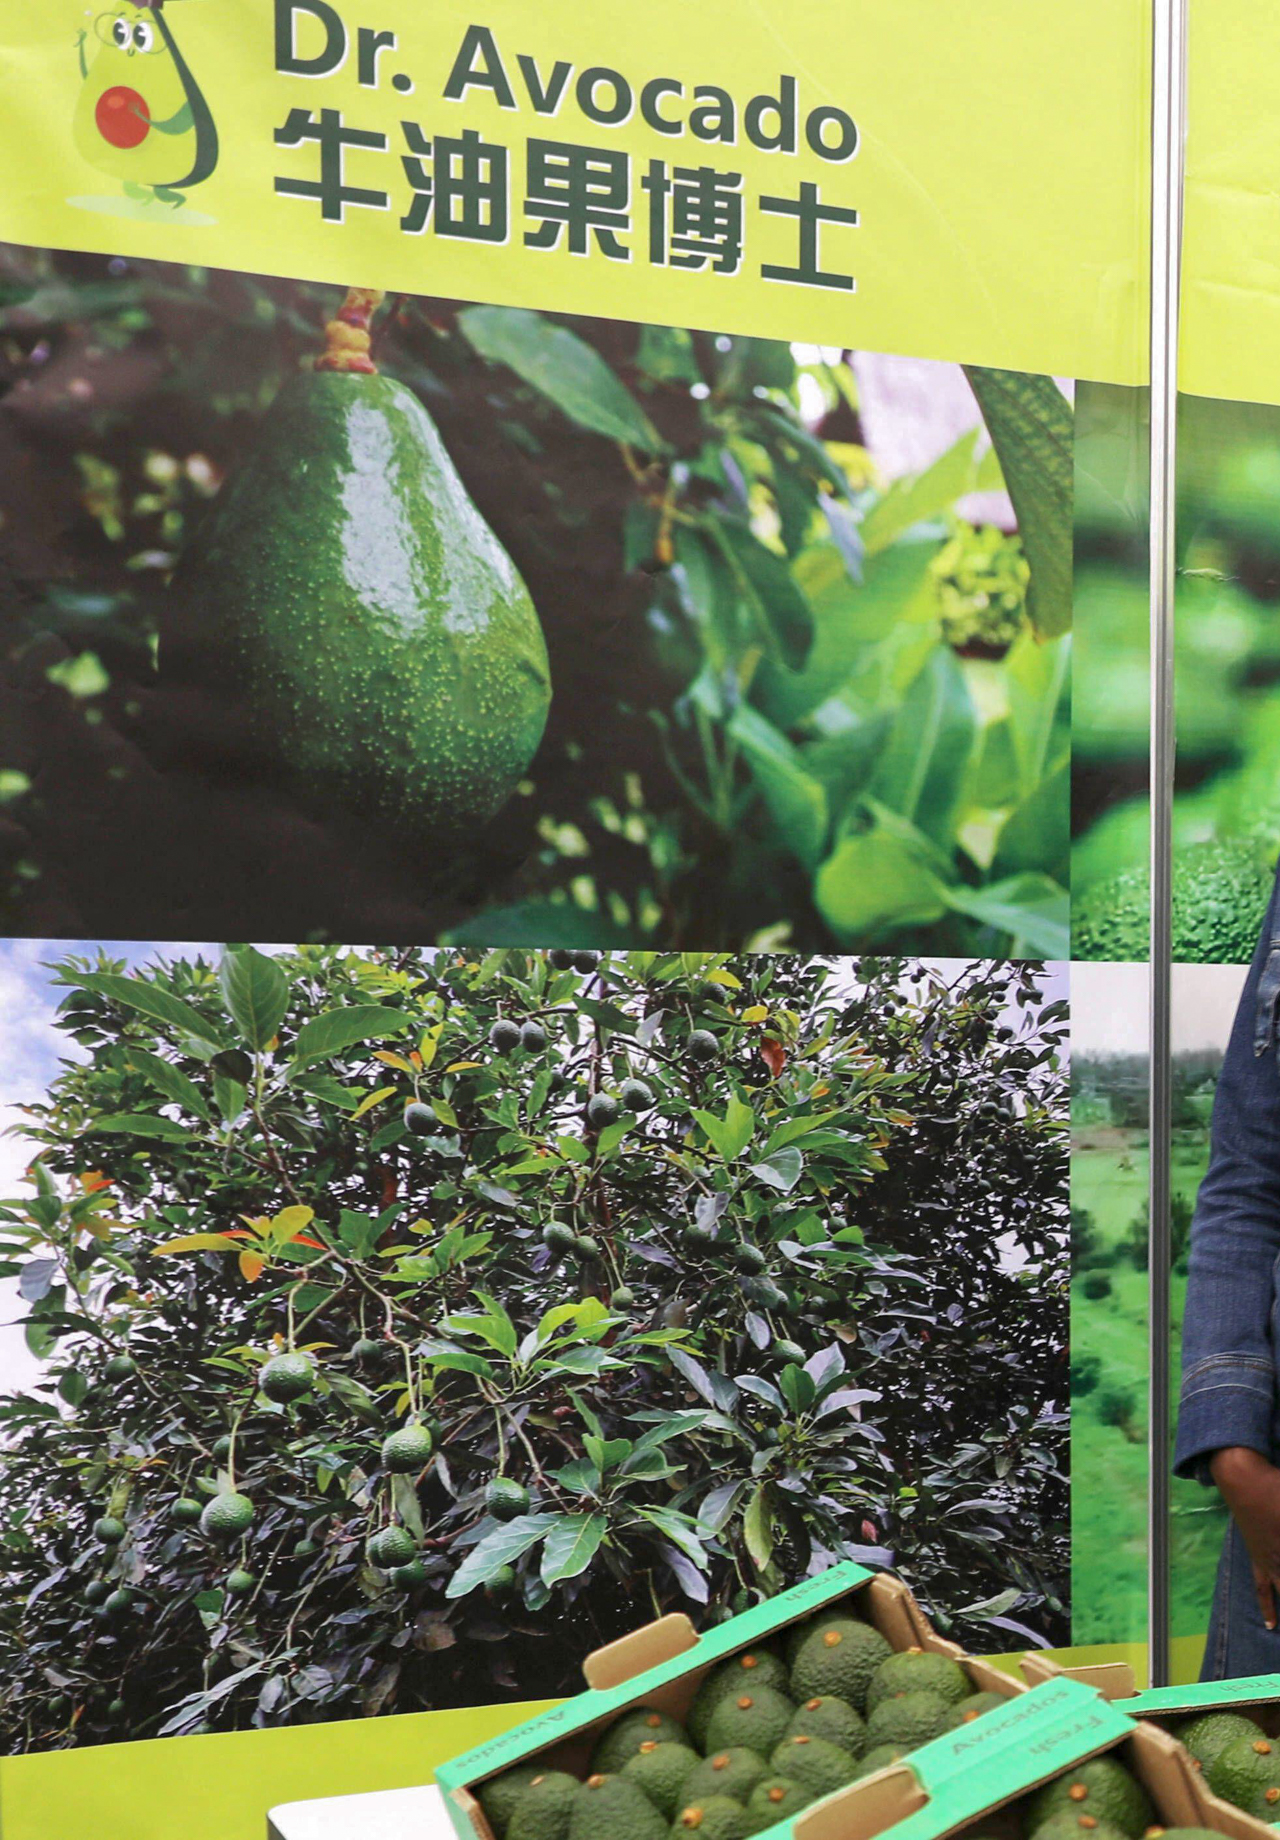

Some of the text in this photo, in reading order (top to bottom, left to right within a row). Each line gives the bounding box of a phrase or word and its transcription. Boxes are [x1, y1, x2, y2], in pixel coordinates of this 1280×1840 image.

[273, 0, 860, 162] Dr. Avocado
[273, 107, 860, 293] 牛油果博士
[455, 1570, 847, 1769] Fresh Avocados
[953, 1690, 1070, 1755] Avocados
[1219, 1680, 1280, 1693] Fresh
[1029, 1714, 1104, 1755] Fresh
